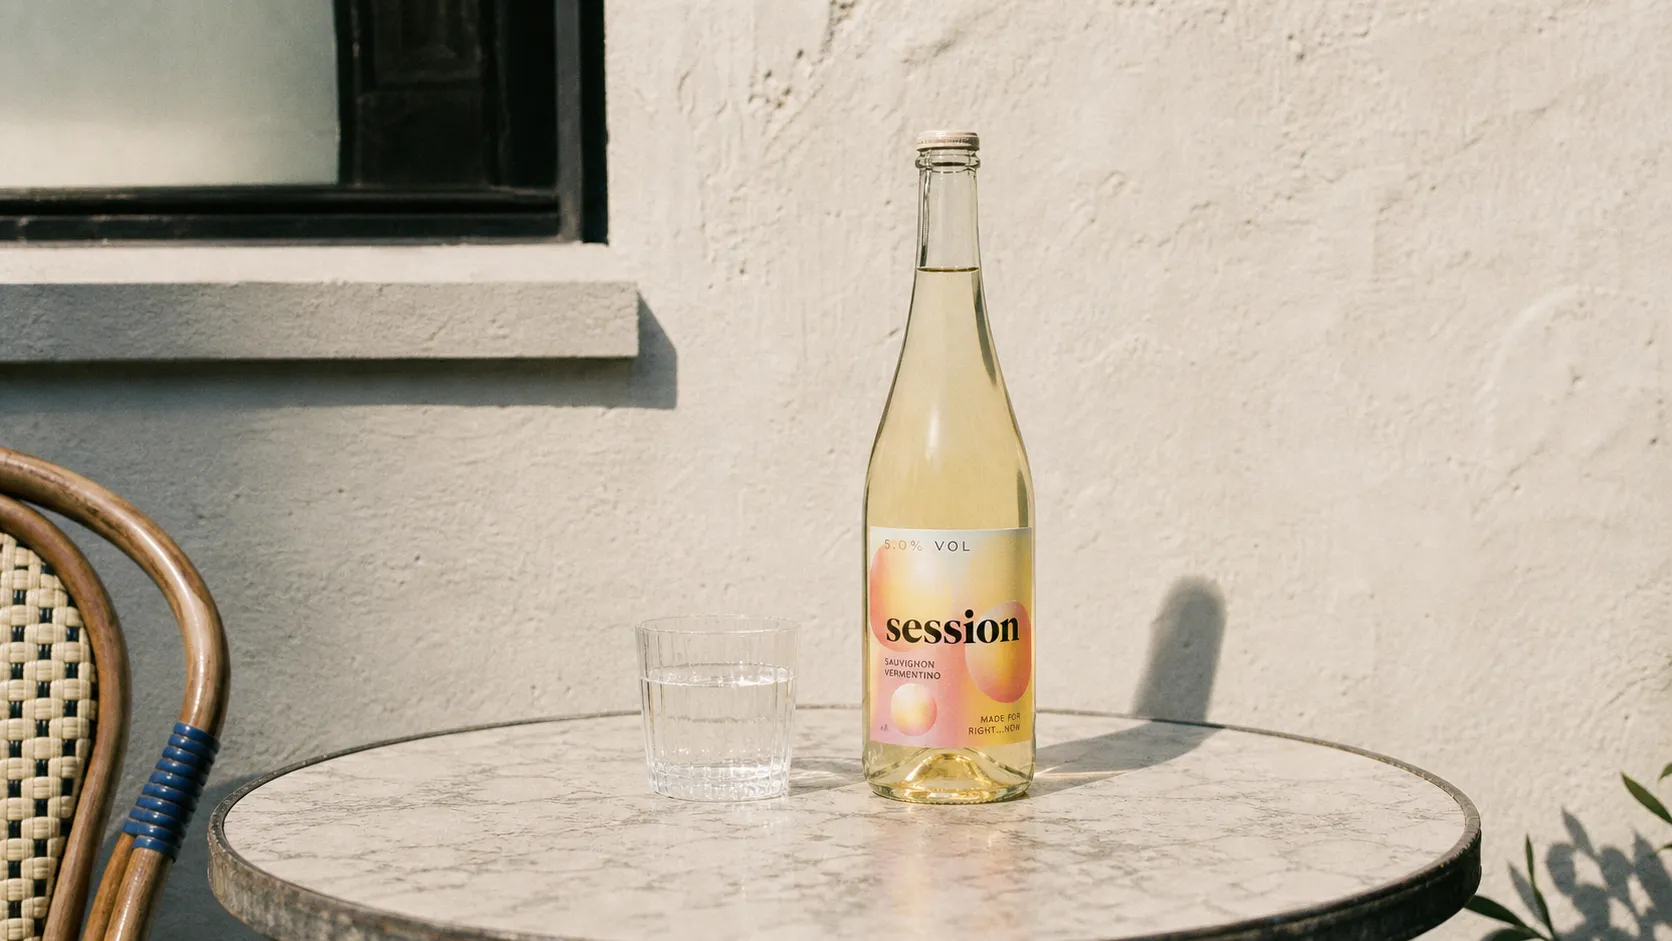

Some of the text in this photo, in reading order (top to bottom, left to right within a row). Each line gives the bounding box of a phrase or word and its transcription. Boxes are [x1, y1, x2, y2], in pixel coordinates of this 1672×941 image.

[884, 538, 970, 552] 5.0% VOL
[886, 609, 1019, 645] session
[884, 657, 935, 669] SAUVIGNON
[884, 668, 941, 680] VERMENTINO
[980, 712, 1021, 723] MADE FOR
